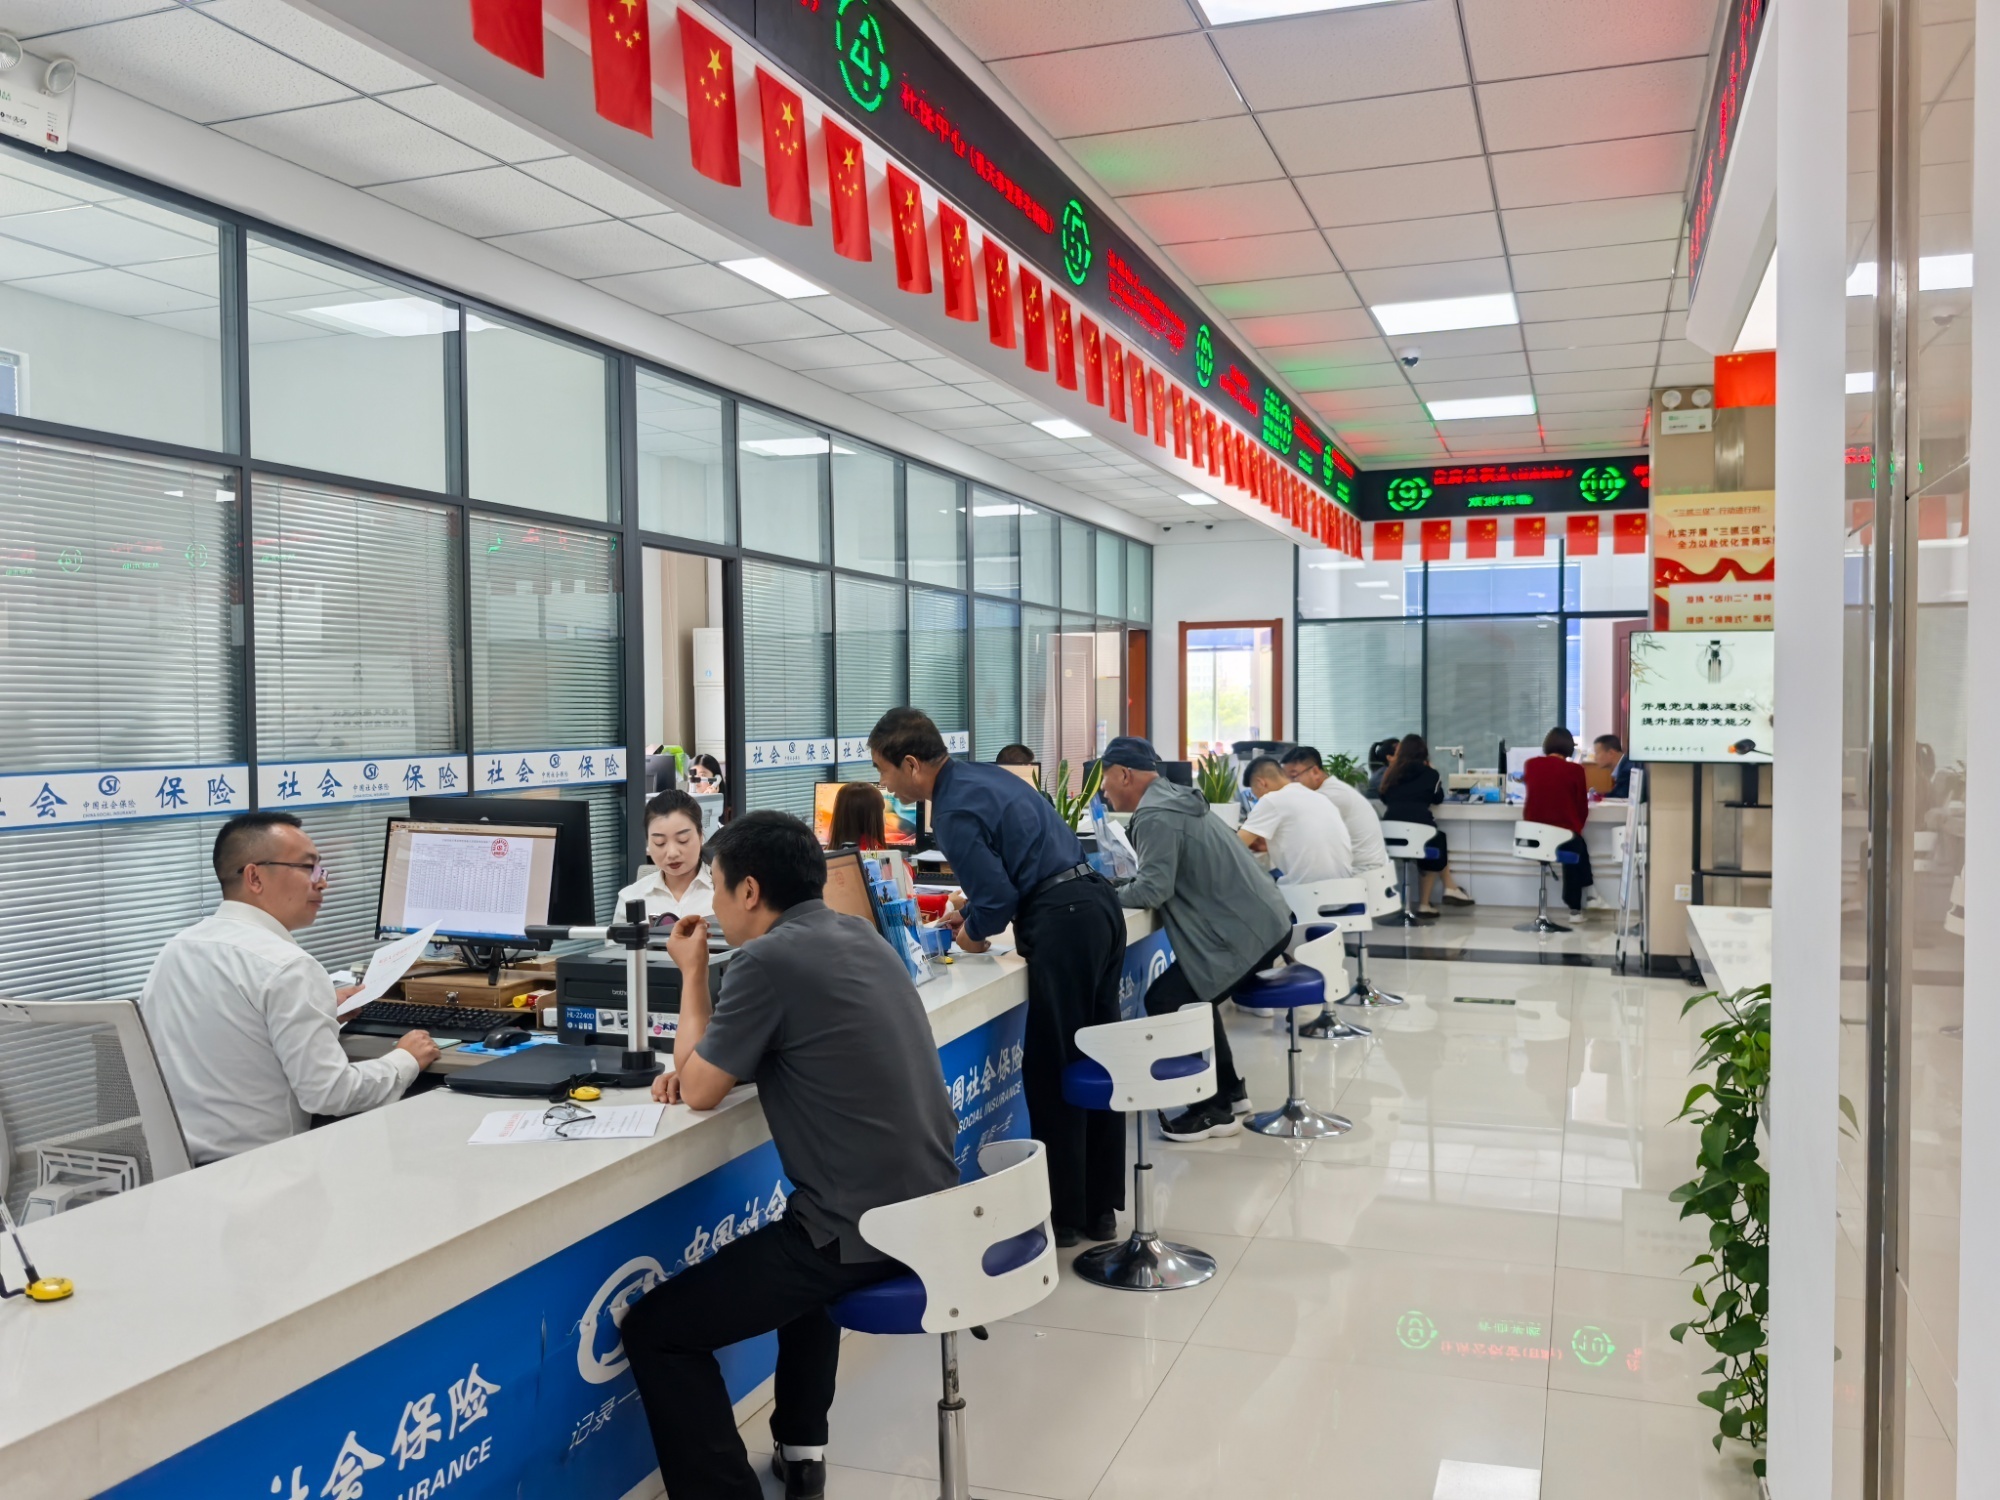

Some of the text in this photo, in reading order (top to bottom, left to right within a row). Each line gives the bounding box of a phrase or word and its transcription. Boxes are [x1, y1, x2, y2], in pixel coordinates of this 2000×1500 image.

[849, 19, 873, 92] 4
[1070, 214, 1082, 271] 5
[1400, 479, 1417, 506] 9
[1588, 473, 1614, 495] 10
[1668, 525, 1775, 538] 扎实开展“三抓三促”
[1678, 537, 1775, 549] 全力以赴优化营商环
[83, 799, 137, 812] 中国社会保险
[566, 1011, 595, 1020] HL-2240D
[957, 1080, 1022, 1134] SOCIAL INSURANCE
[569, 1387, 641, 1450] 记录一
[398, 1435, 492, 1500] RANCE
